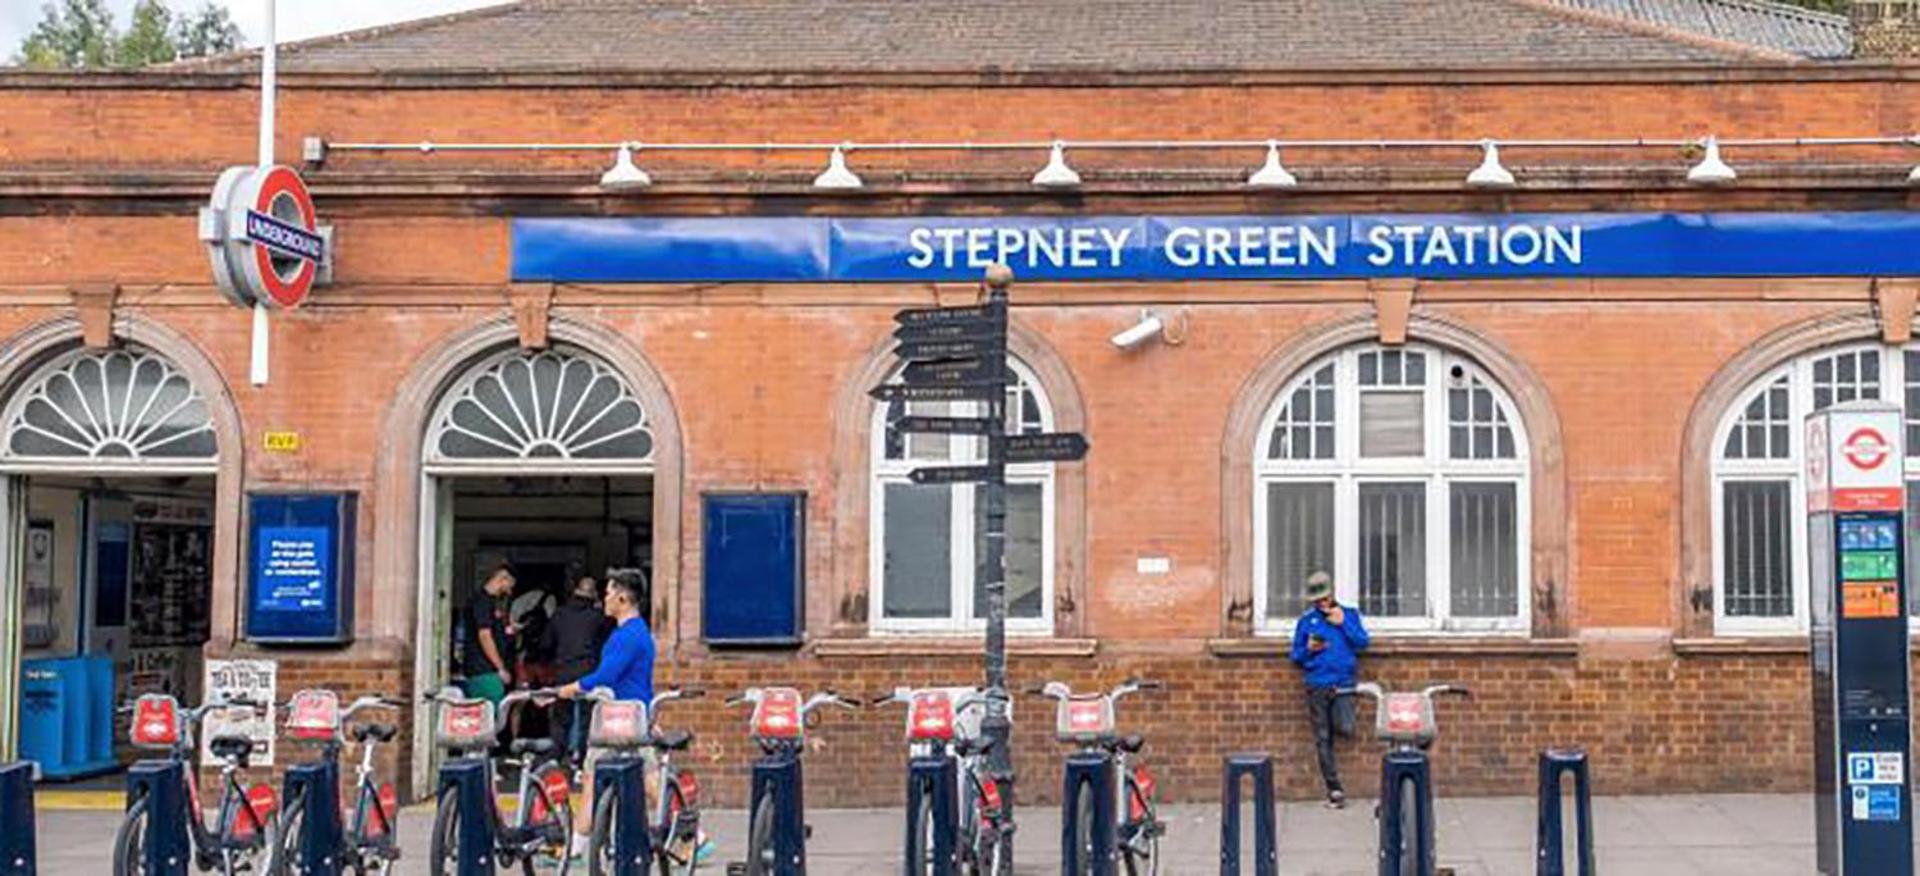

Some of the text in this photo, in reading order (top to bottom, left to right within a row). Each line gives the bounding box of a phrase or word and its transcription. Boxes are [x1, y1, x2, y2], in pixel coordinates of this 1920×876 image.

[249, 215, 320, 256] UNDERGROUND
[907, 224, 1582, 269] STEPNEY GREEN STATION
[1856, 759, 1871, 778] P
